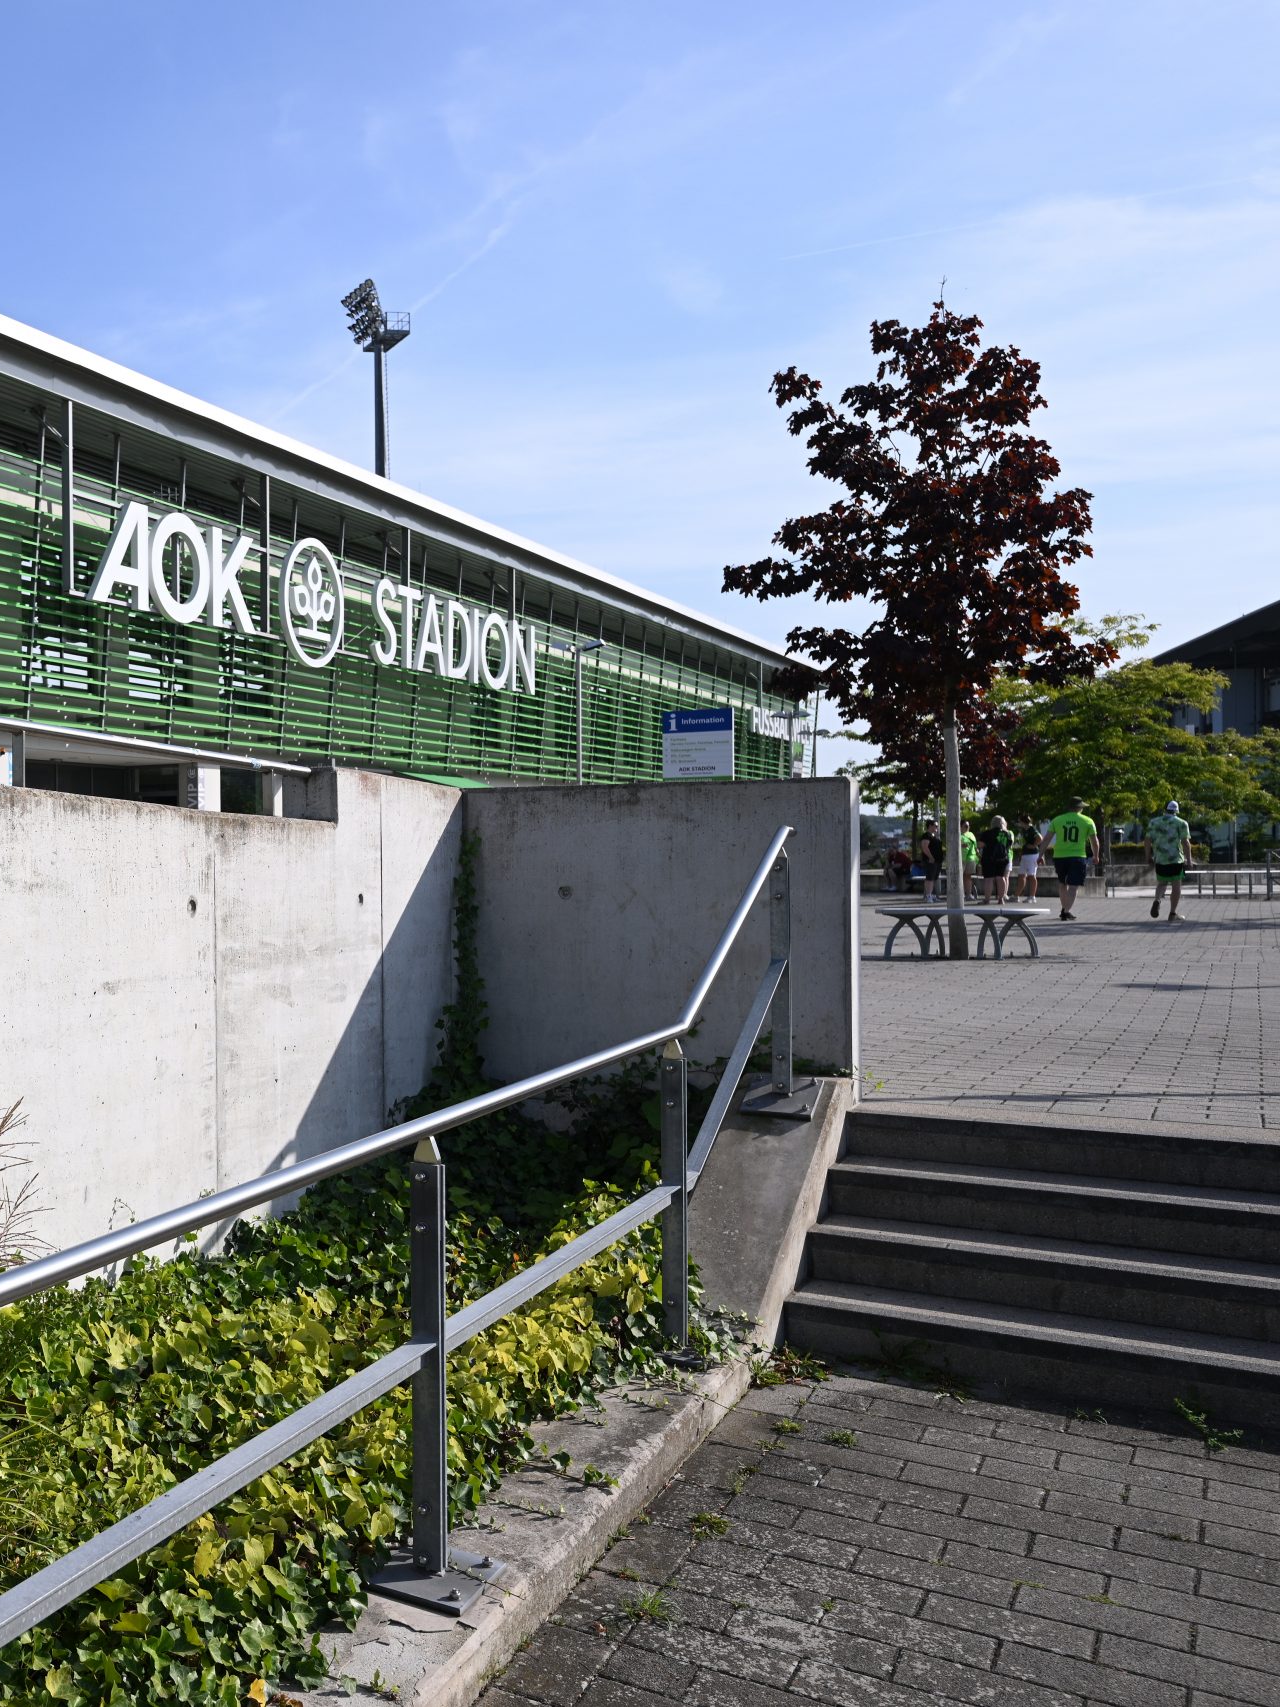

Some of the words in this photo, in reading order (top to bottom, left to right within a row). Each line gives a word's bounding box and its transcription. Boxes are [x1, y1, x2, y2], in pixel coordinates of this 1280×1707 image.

[88, 500, 257, 635] AOK
[371, 578, 536, 696] STADION
[681, 716, 725, 725] Information
[187, 783, 198, 807] VIP
[1063, 825, 1079, 843] 10
